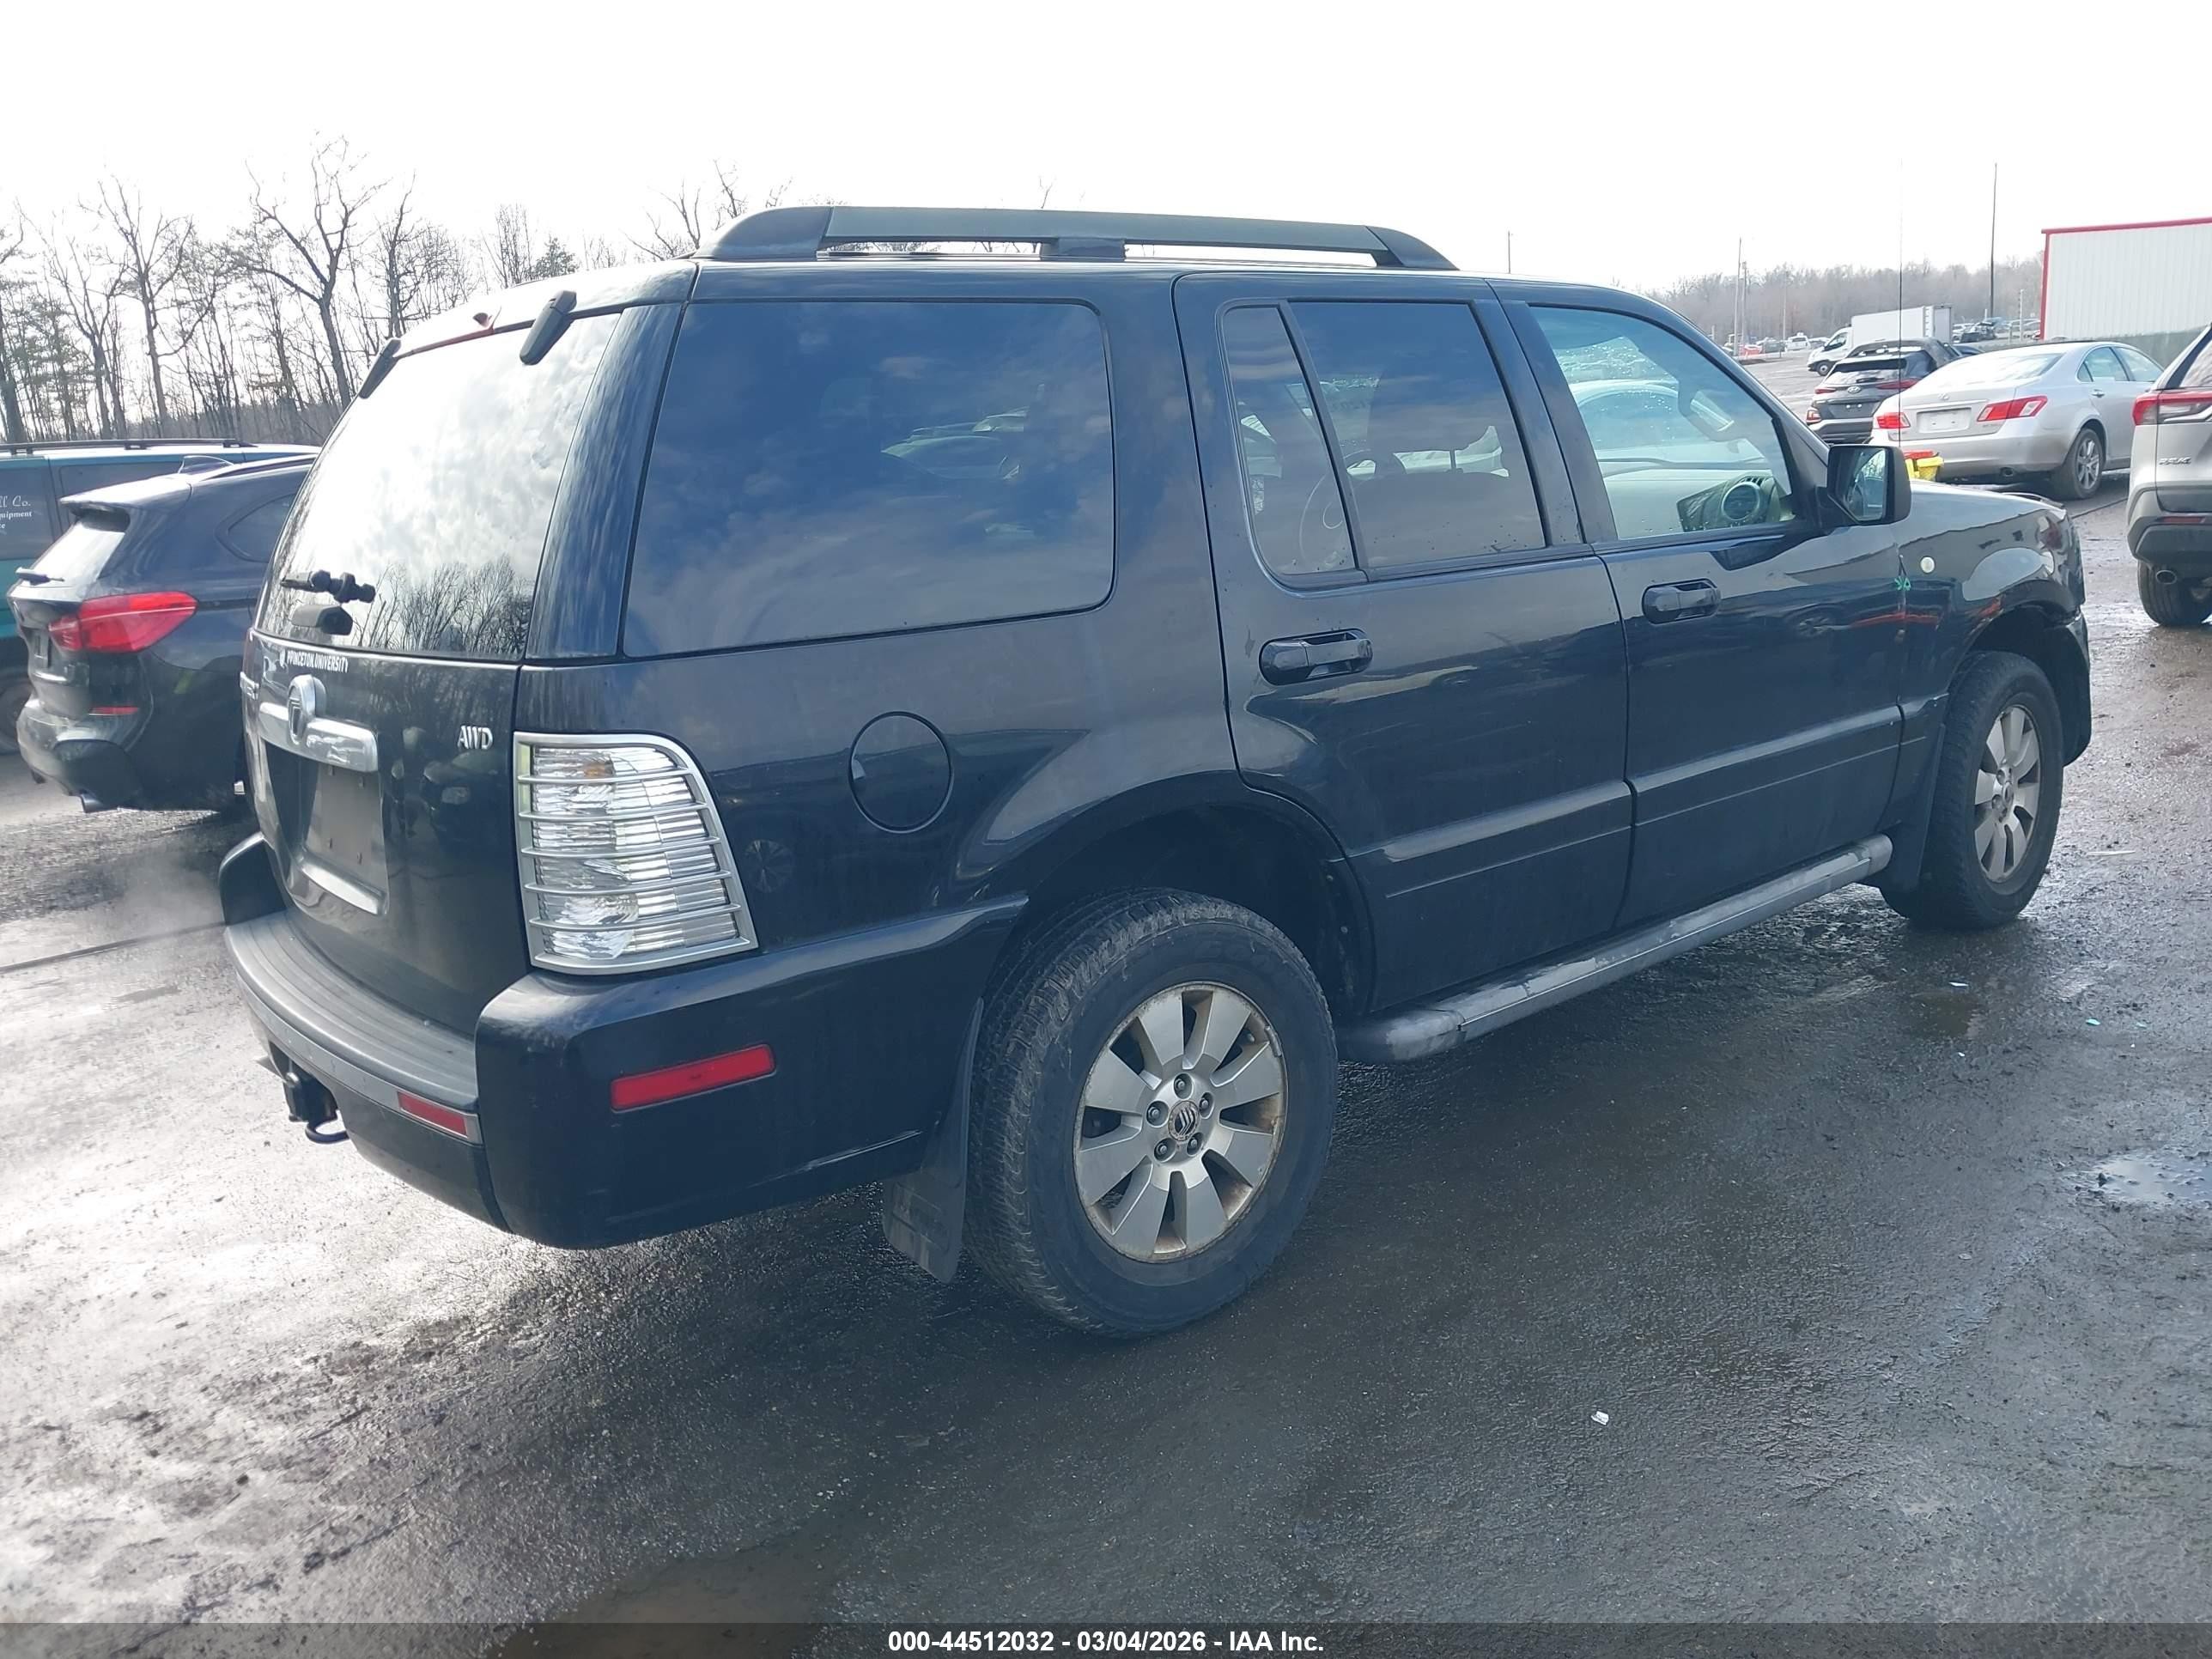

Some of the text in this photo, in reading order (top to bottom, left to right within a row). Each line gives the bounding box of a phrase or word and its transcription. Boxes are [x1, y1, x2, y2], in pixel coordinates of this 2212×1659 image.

[12, 495, 31, 507] Co.
[287, 650, 349, 673] PRINCETON UNIVERSITY
[457, 725, 494, 750] AWD
